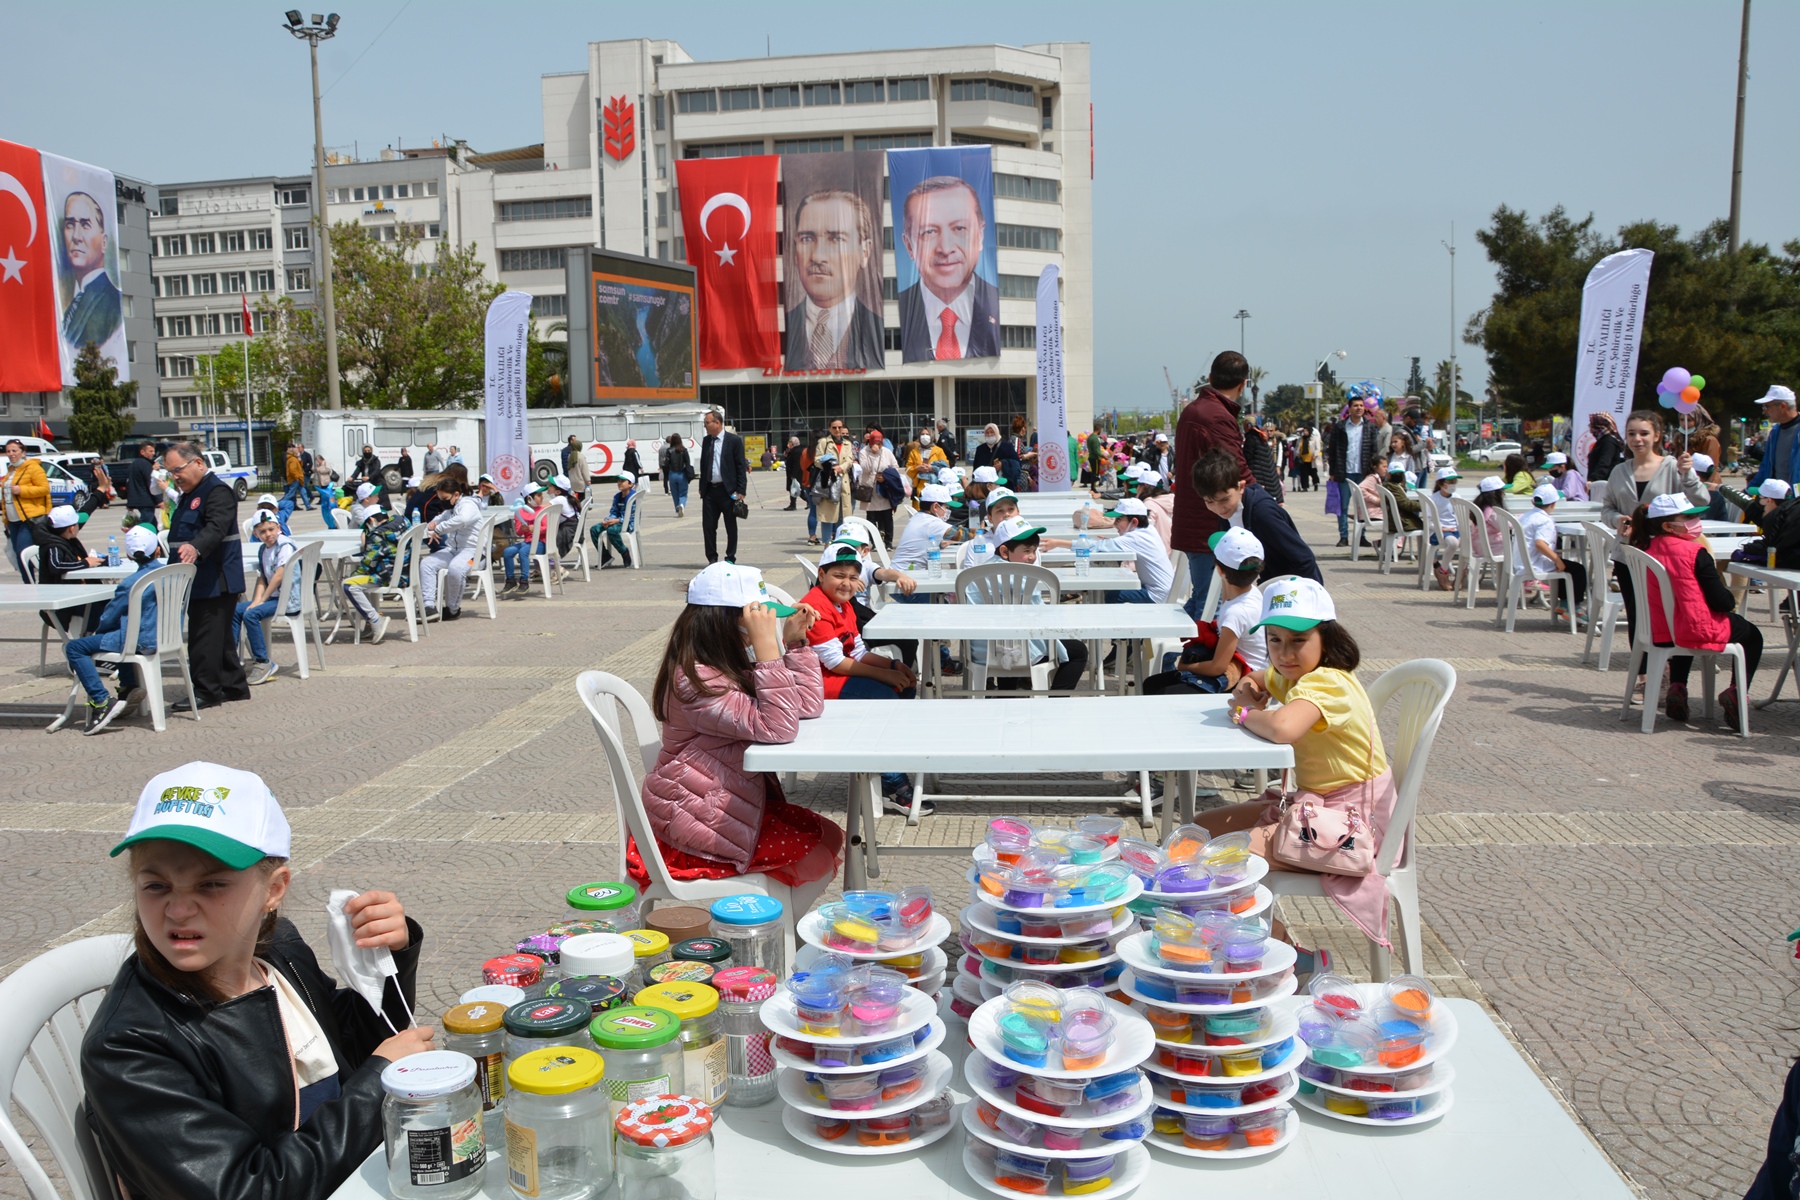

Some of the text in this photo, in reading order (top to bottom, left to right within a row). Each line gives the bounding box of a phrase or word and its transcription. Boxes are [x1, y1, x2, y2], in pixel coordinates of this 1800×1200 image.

[116, 179, 146, 204] Bank
[206, 187, 246, 199] OTEL
[598, 284, 626, 296] samsun
[1625, 283, 1642, 333] Müdürlüğü
[1594, 308, 1612, 386] SAMSUN VALİLİĞİ
[1610, 320, 1622, 361] Şehircilik
[1048, 336, 1056, 377] Şehircilik
[1618, 342, 1634, 389] Değişikliği
[1606, 363, 1618, 389] Çevre,
[497, 382, 505, 417] SAMSUN
[1614, 390, 1626, 414] İklim
[535, 1006, 560, 1018] tat
